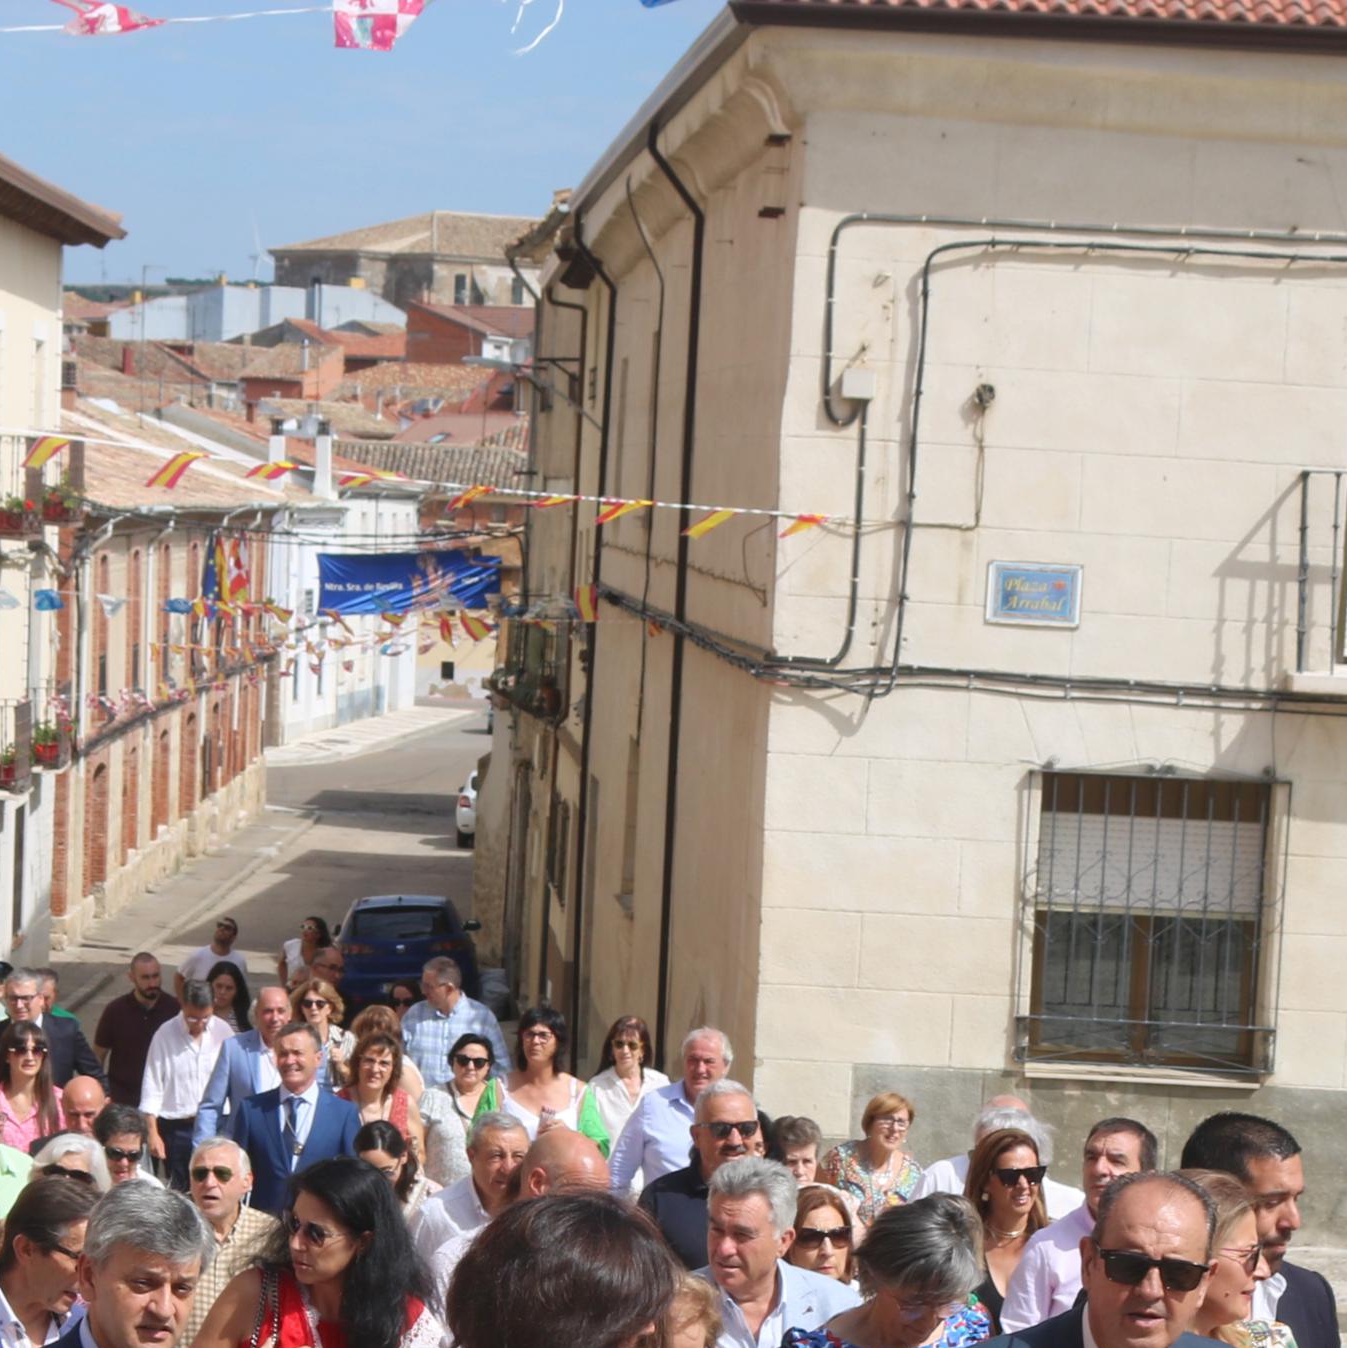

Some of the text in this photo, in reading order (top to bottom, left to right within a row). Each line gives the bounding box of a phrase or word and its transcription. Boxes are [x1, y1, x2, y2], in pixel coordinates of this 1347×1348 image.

[324, 582, 345, 592] Ntra.
[1004, 576, 1047, 592] Plaza
[1004, 596, 1067, 611] Arrabal
